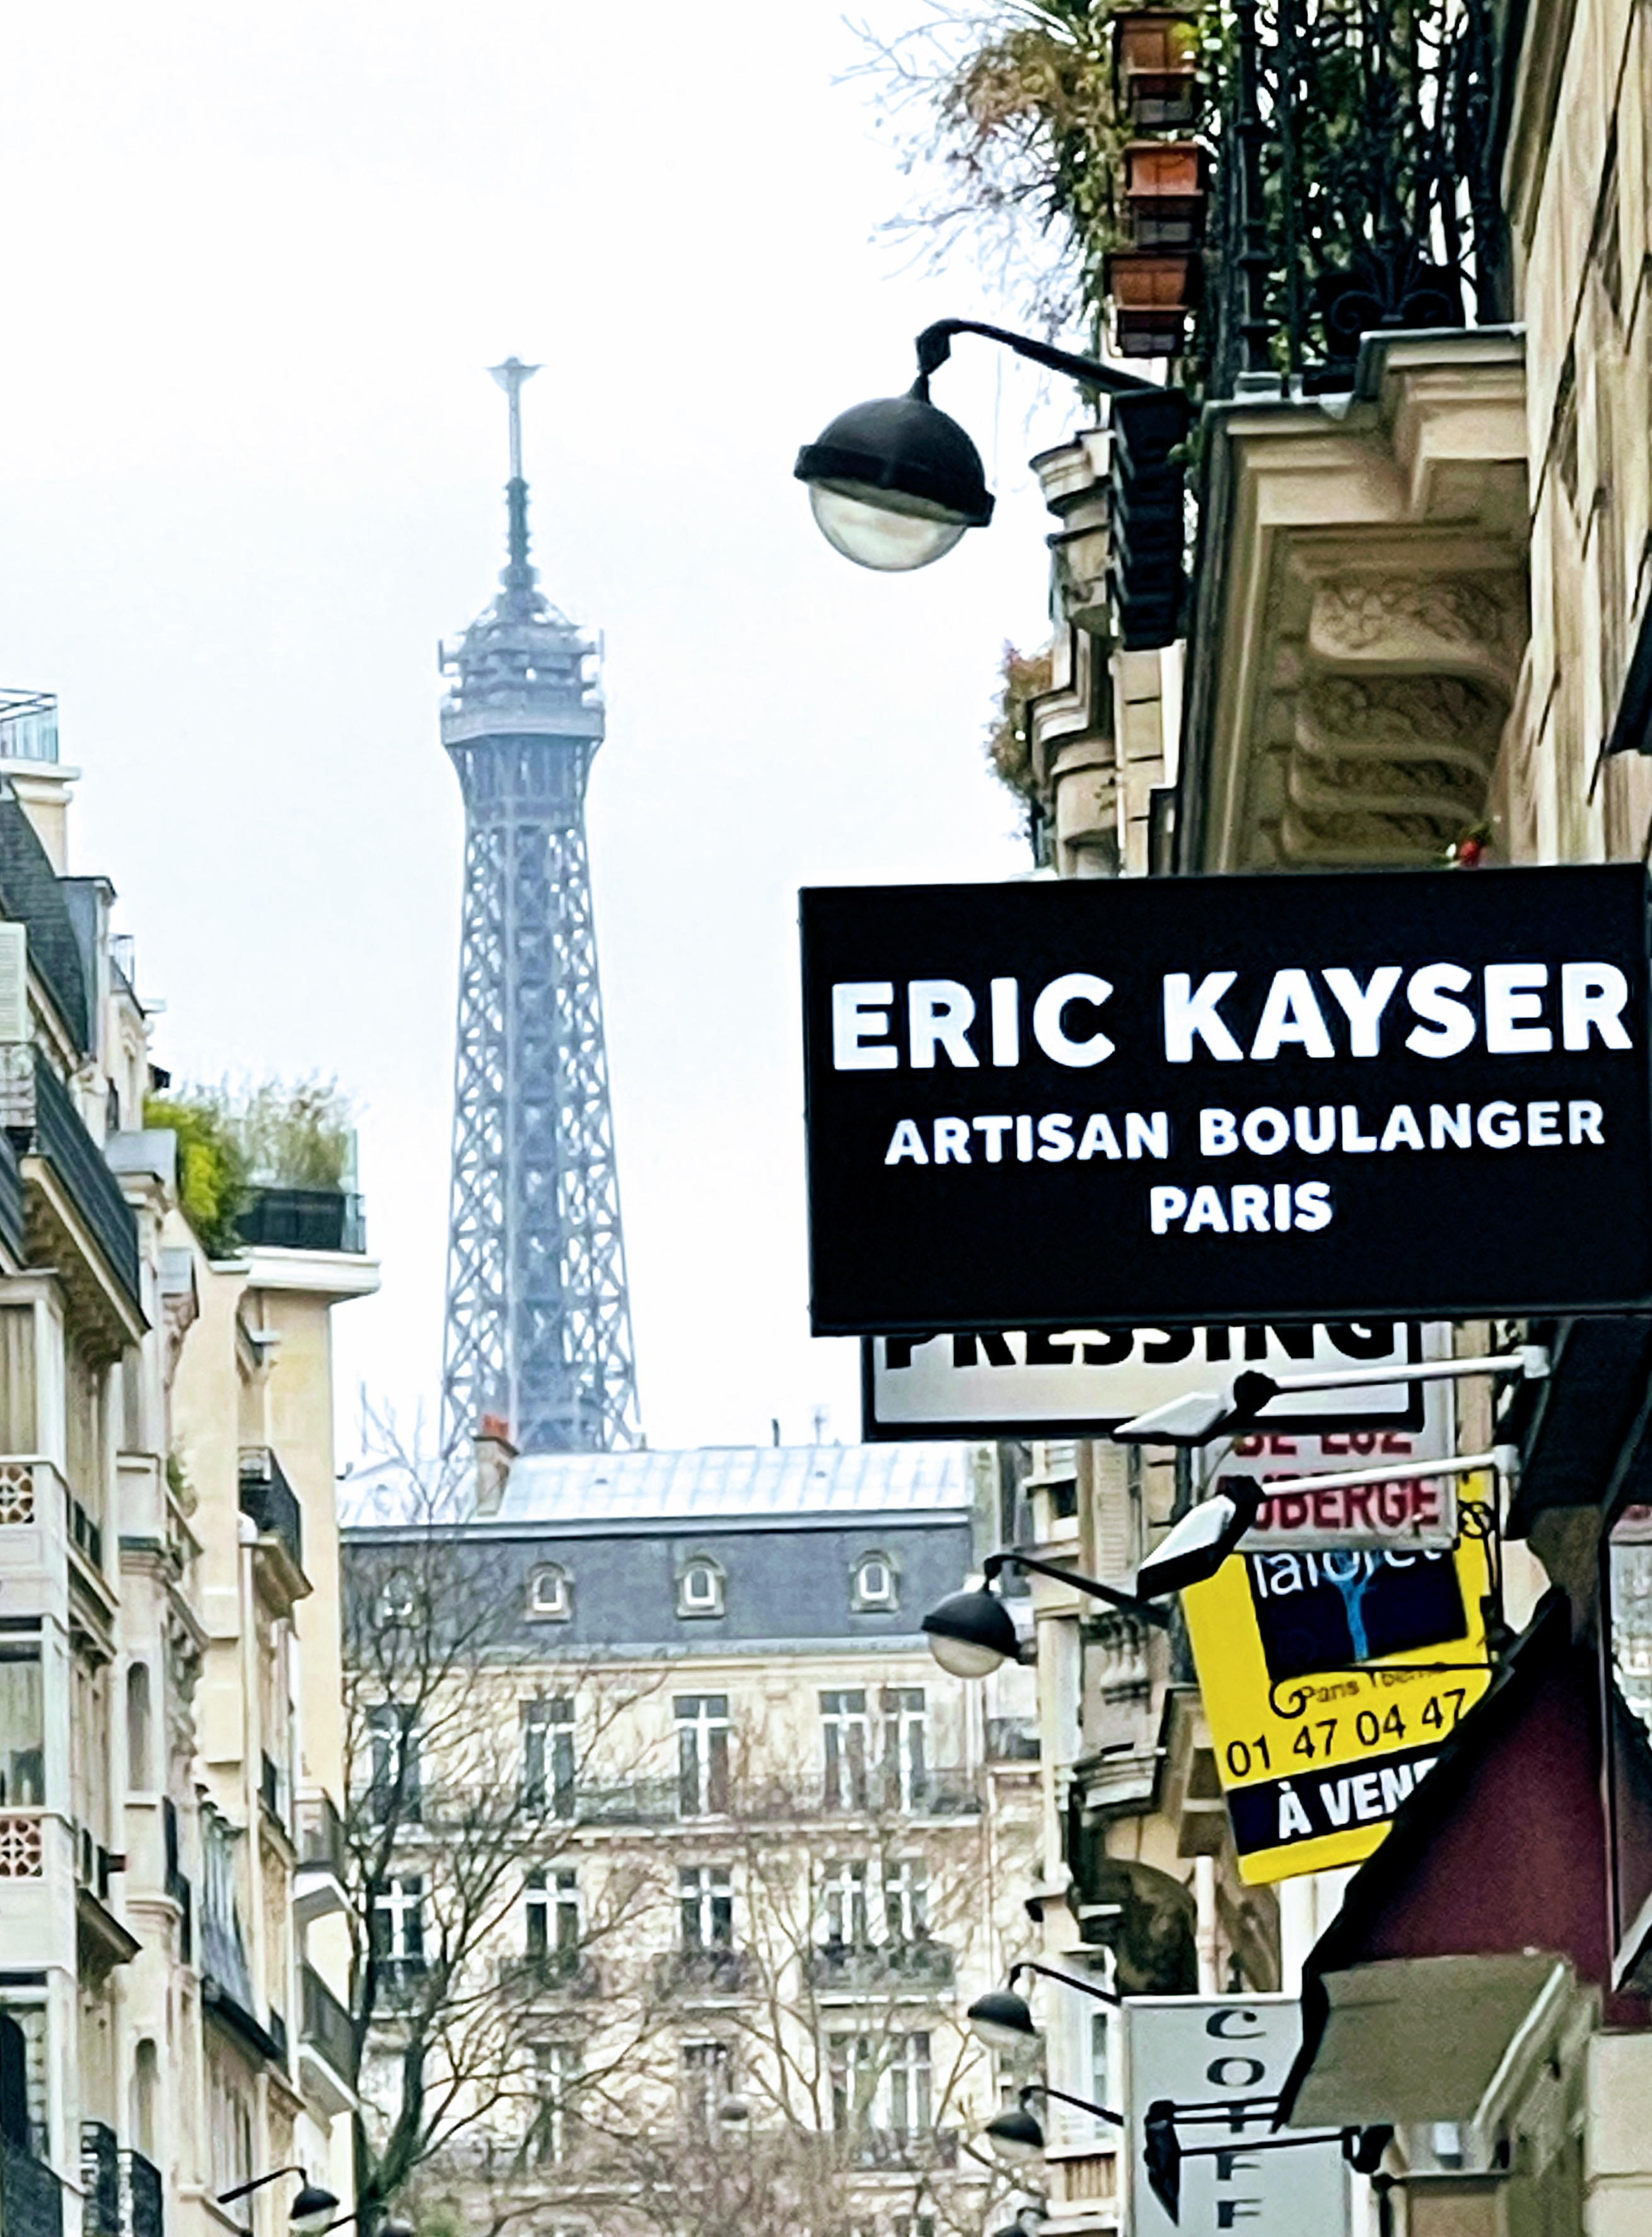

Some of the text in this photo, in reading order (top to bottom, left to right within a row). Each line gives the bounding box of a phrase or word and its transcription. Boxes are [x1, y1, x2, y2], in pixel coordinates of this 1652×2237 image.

[832, 963, 1632, 1070] ERIC KAYSER
[885, 1101, 1604, 1164] ARTISAN BOULANGER
[1151, 1182, 1332, 1234] PARIS
[1252, 1473, 1440, 1531] BERGE
[1227, 1688, 1466, 1777] 01 47 04 47
[1279, 1782, 1312, 1839] À
